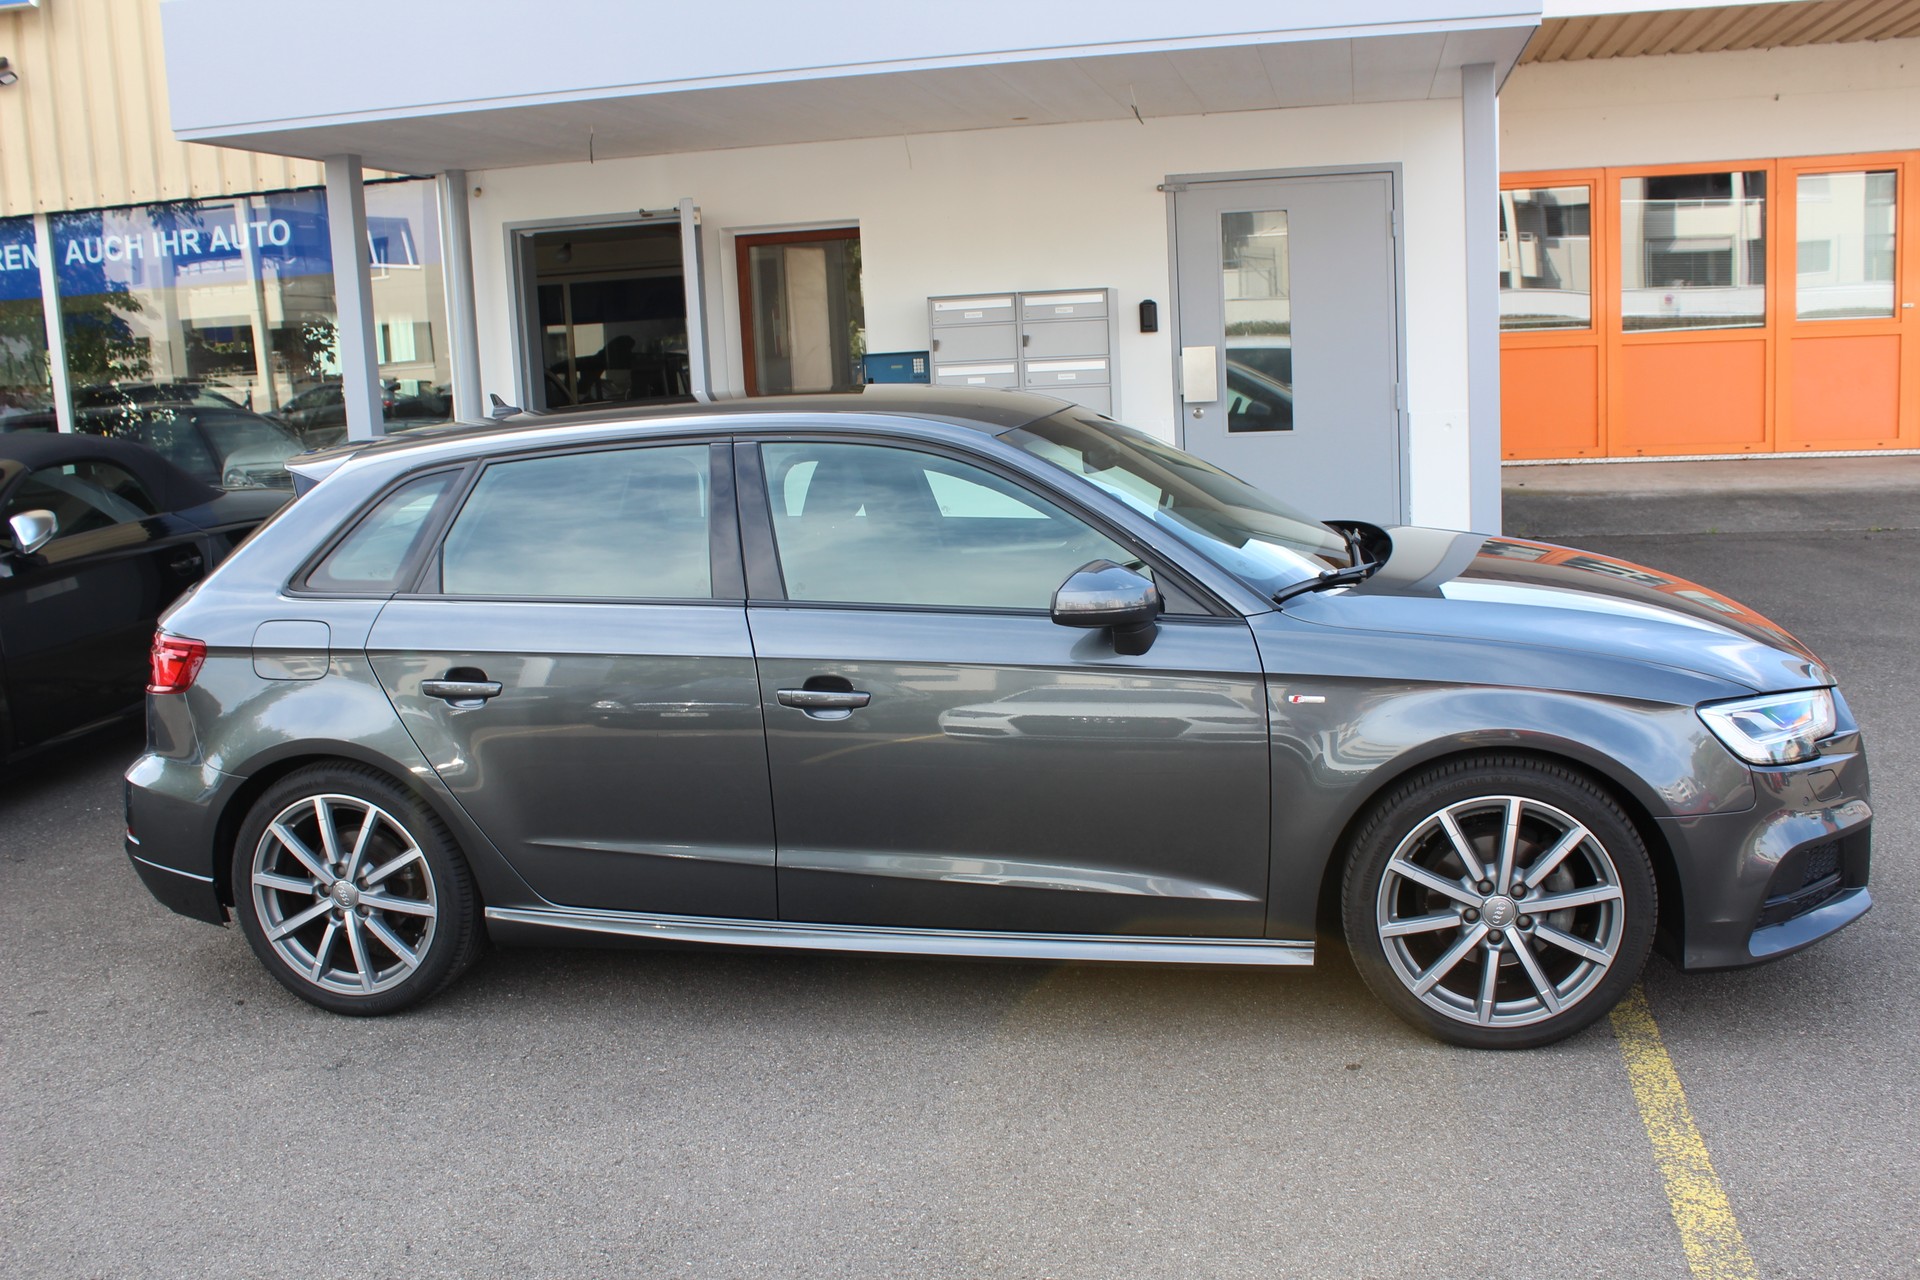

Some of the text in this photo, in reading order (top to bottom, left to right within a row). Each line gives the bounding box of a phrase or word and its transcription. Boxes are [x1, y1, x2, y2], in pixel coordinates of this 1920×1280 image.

[0, 219, 291, 271] EN AUCH IHR AUTO
